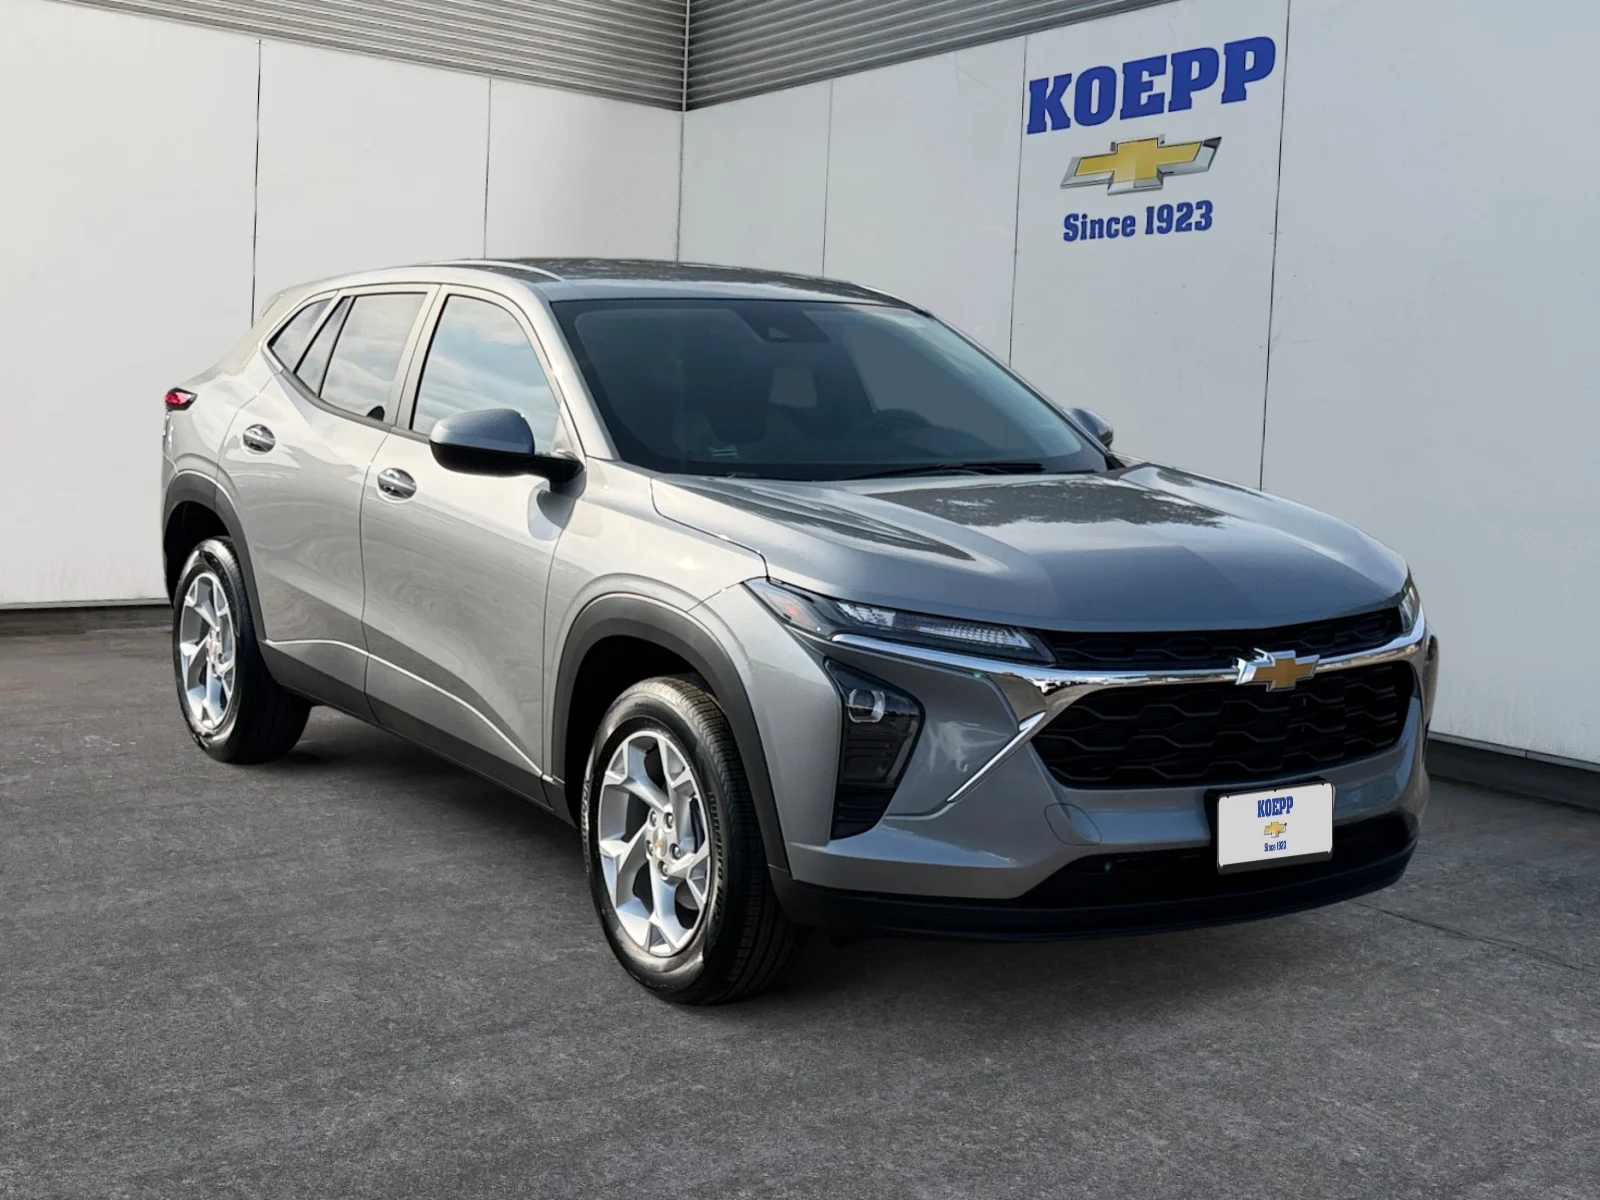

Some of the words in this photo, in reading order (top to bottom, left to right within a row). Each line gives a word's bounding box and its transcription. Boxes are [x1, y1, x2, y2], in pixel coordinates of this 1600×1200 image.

[1026, 36, 1277, 135] KOEPP
[1063, 213, 1136, 242] Since
[1145, 200, 1213, 235] 1923
[1257, 796, 1294, 818] KOEPP
